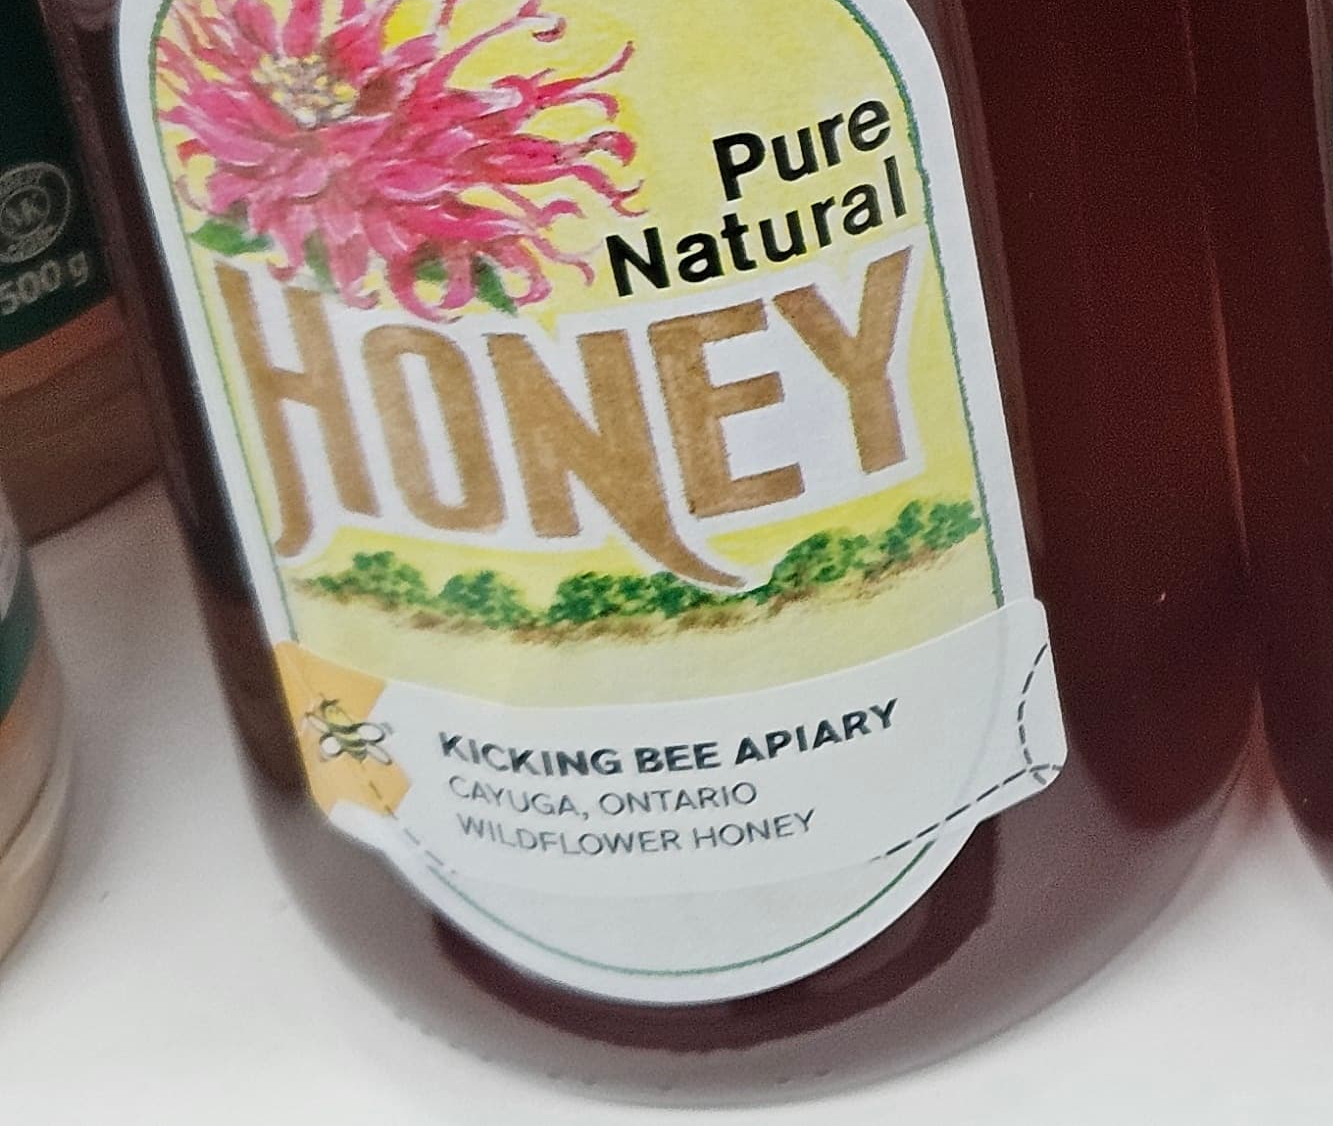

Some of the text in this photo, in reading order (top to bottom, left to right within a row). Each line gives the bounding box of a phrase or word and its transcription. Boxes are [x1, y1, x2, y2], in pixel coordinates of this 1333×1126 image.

[713, 100, 891, 201] Pure
[606, 156, 907, 296] Natural
[0, 259, 61, 315] 500
[213, 246, 913, 588] HONEY
[439, 697, 899, 776] KICKING BEE APIARY
[448, 775, 757, 820] CAYUGA, ONTARIO
[456, 809, 816, 855] WILDFLOWER HONEY
